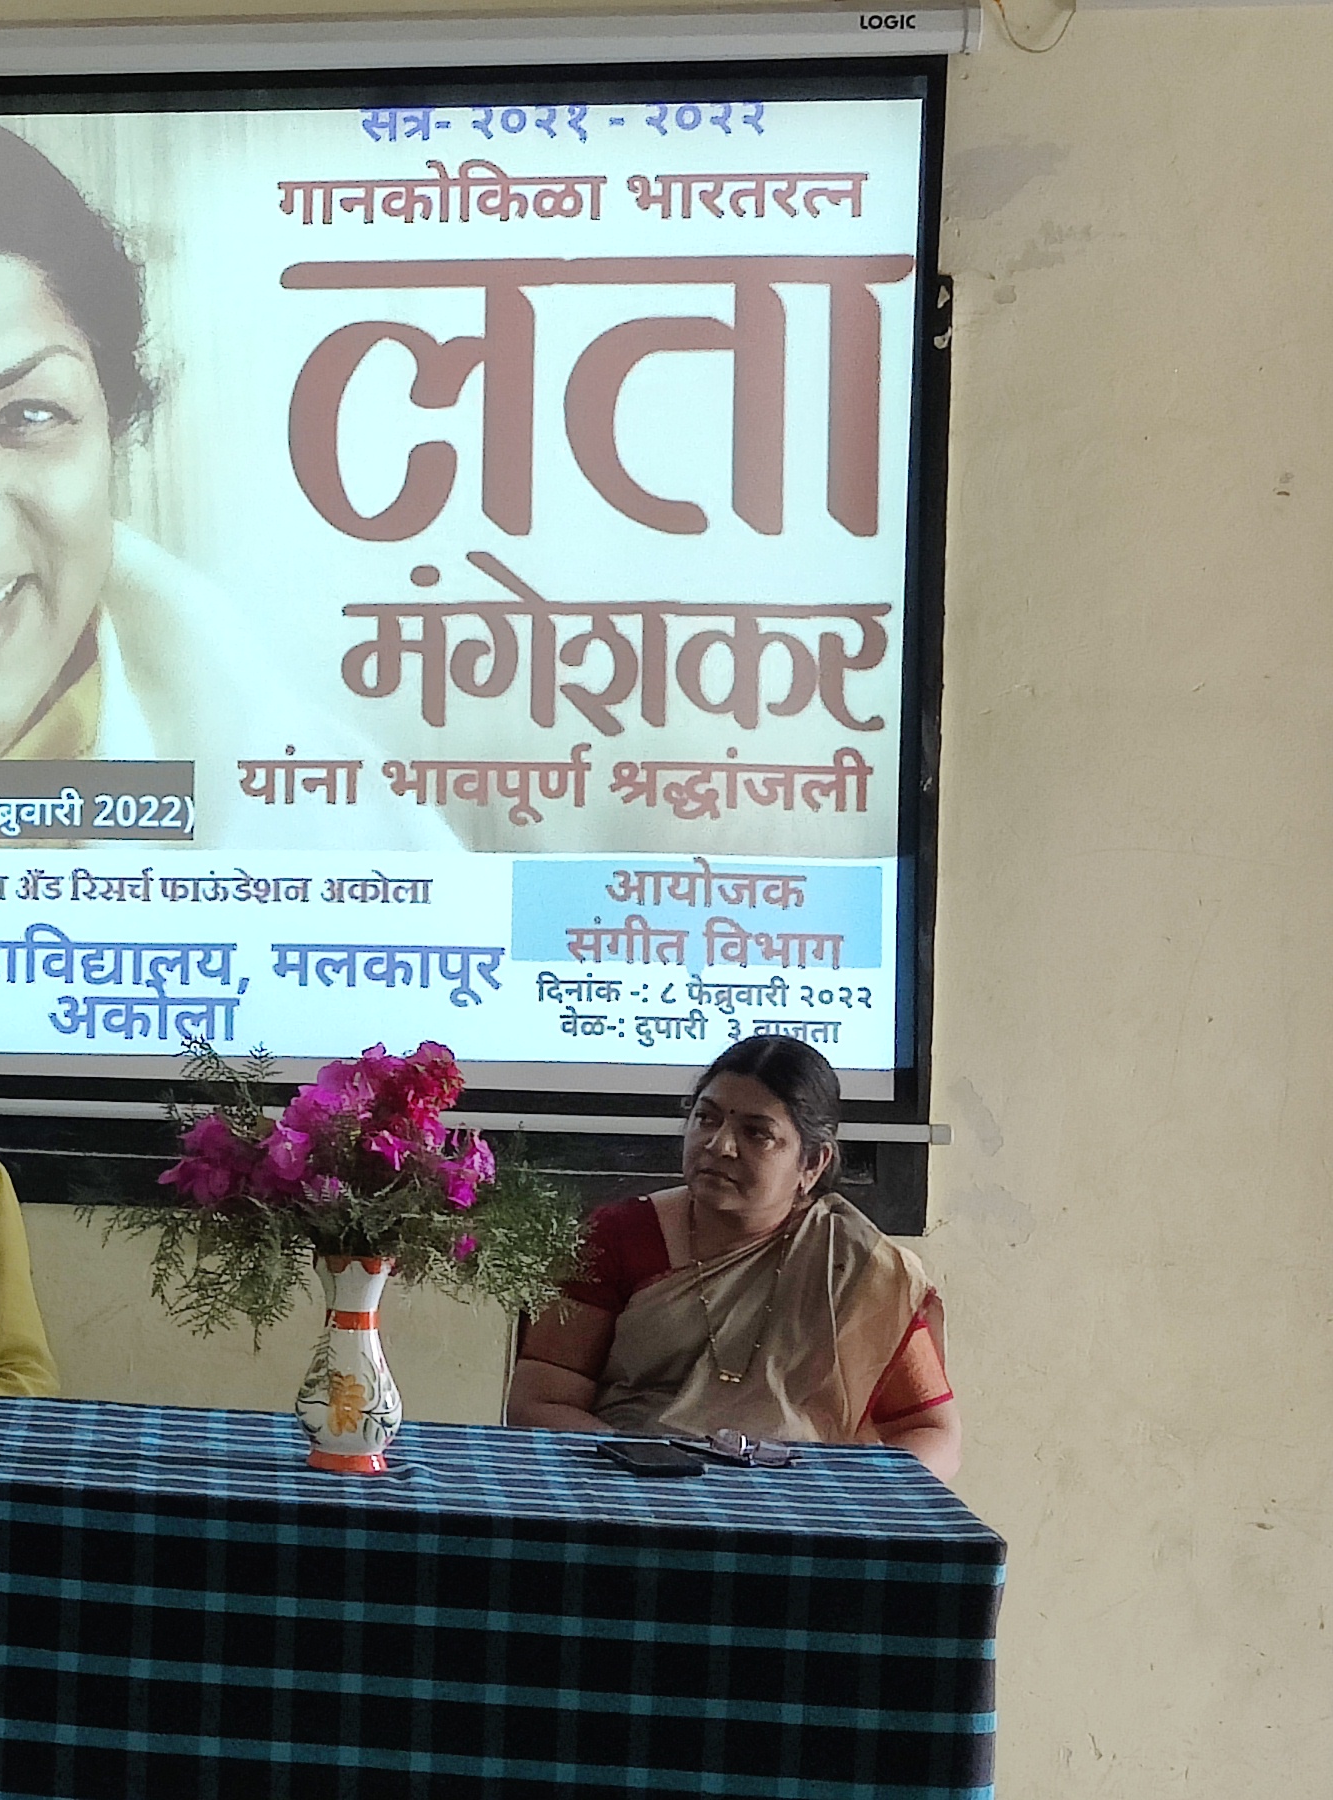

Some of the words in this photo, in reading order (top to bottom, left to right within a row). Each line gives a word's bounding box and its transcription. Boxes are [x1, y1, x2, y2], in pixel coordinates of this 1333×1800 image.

[859, 14, 917, 30] LOGIC
[278, 158, 608, 226] गानकोकिळा
[627, 171, 869, 222] भारतरत्न
[280, 254, 915, 543] लता
[340, 551, 892, 737] मंगेशकर
[238, 745, 365, 806] यांना
[382, 743, 592, 825] भावपूर्ण
[610, 746, 874, 820] श्रद्धांजली
[93, 792, 196, 834] 2022)
[71, 867, 155, 902] रिसर्च
[159, 867, 313, 904] फाऊंडेशन
[321, 868, 434, 904] अकोला
[606, 856, 807, 910] आयोजक
[566, 914, 690, 966] संगीत
[704, 916, 845, 970] विभाग
[271, 942, 505, 1007] मलकापूर
[536, 971, 623, 1004] दिनांक
[660, 982, 677, 1004] ८
[685, 973, 790, 1015] फेब्रुवारी
[800, 985, 873, 1009] २०२२
[48, 978, 241, 1041] अकोला
[635, 1008, 709, 1047] दुपारी
